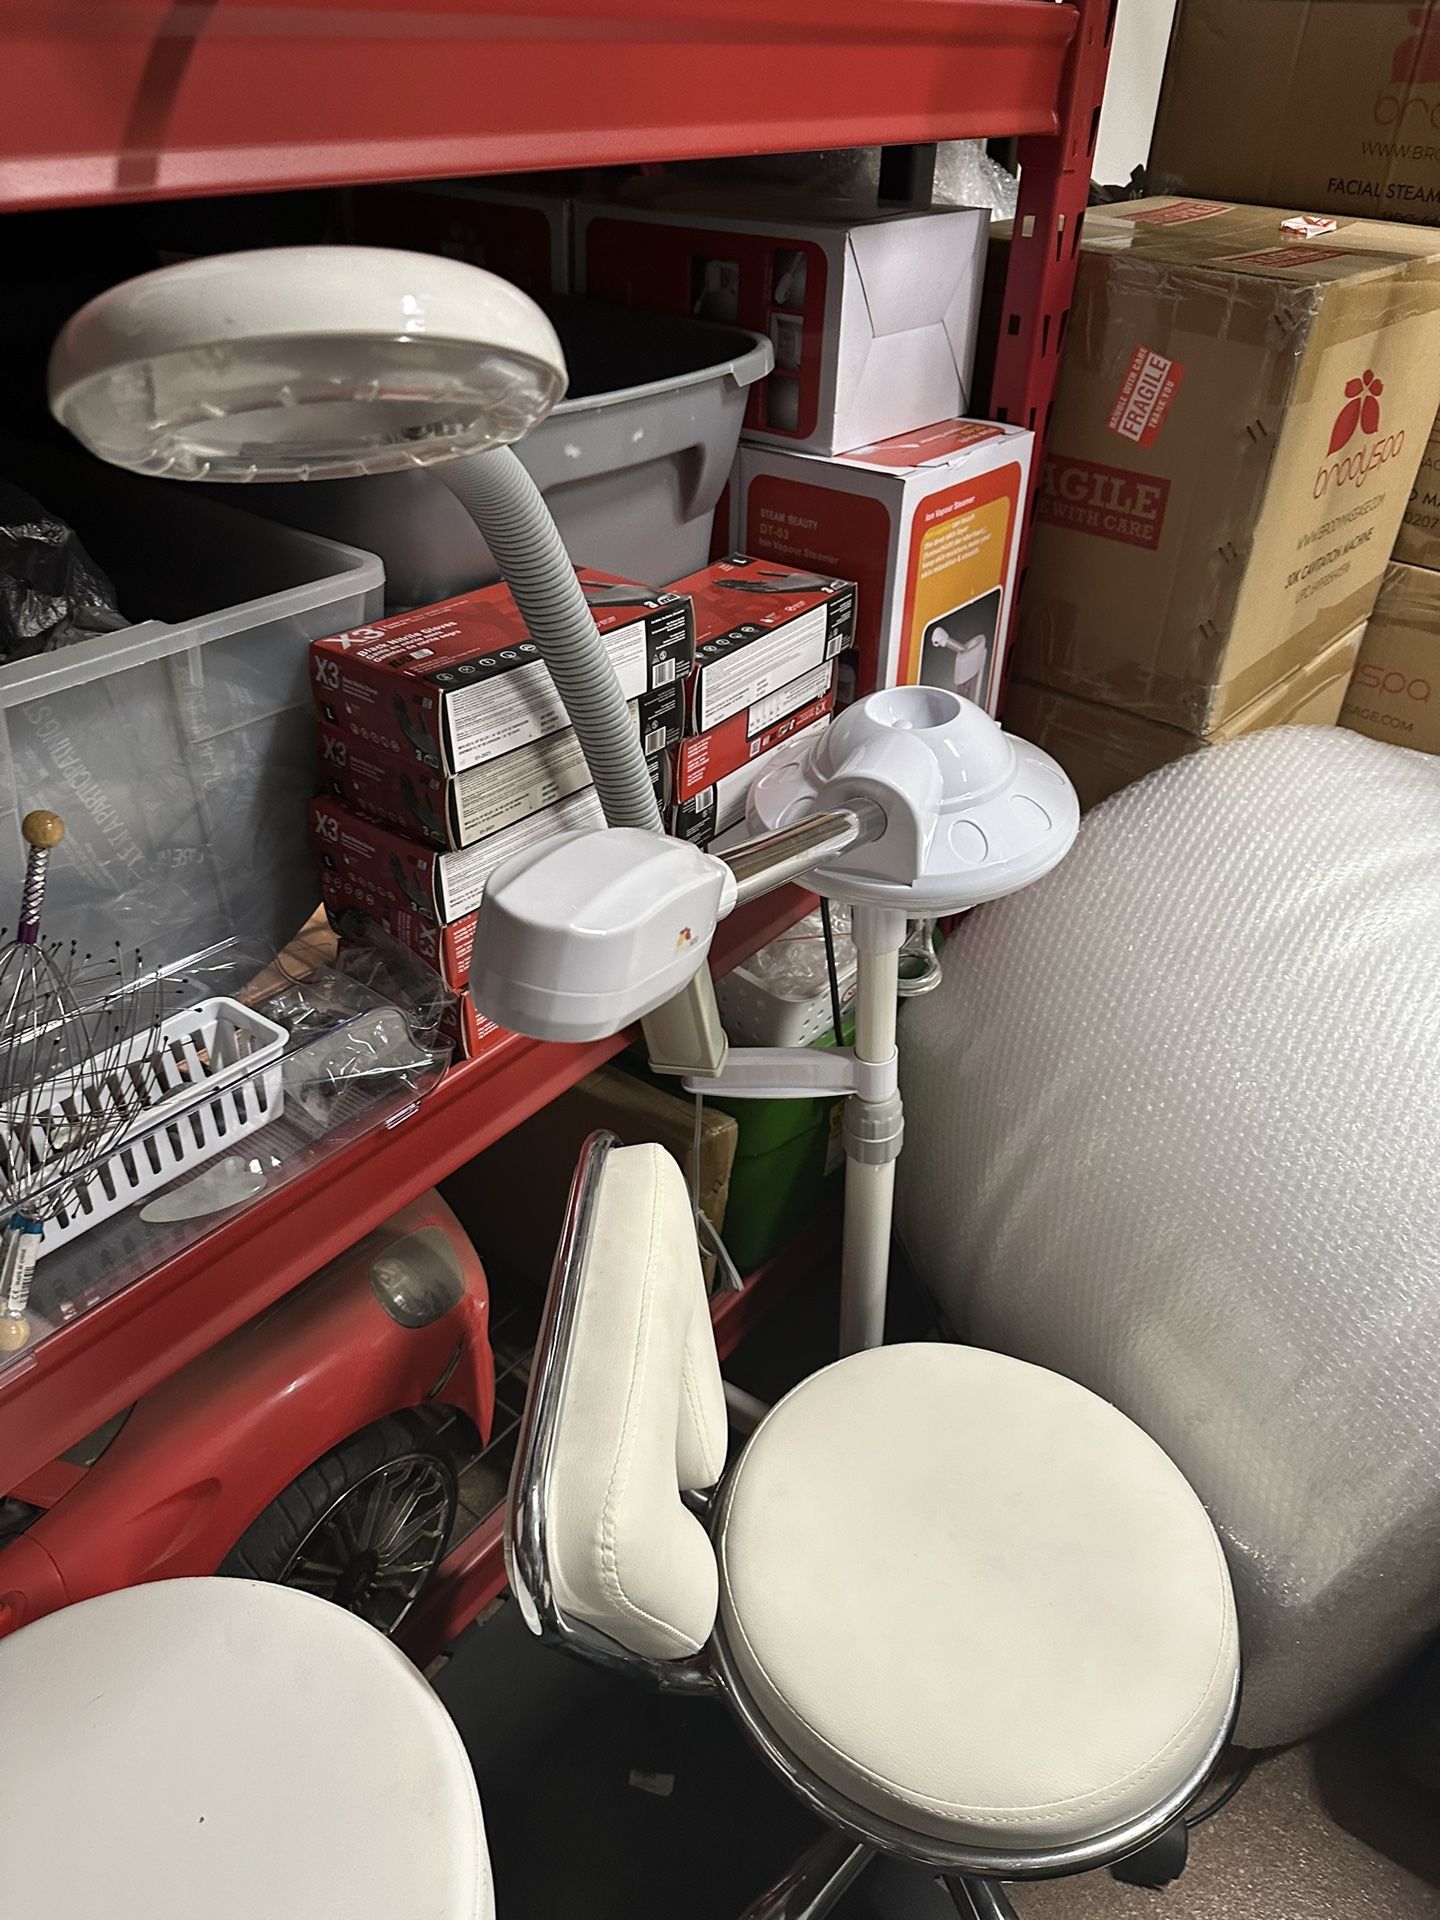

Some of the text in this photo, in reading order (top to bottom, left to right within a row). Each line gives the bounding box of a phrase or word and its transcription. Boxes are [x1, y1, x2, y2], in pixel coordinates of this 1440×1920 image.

[1327, 177, 1380, 198] FACIAL
[1109, 347, 1149, 429] HANDLE WITH CARE
[1123, 357, 1168, 436] FRAGILE
[1147, 380, 1175, 428] THANK YOU
[760, 508, 818, 530] STEAM BEAUTY
[760, 523, 790, 540] DT-03
[1053, 500, 1100, 528] WITH
[1103, 514, 1155, 540] CARE
[804, 548, 840, 565] Steamer
[322, 626, 386, 650] X3
[356, 621, 458, 657] Black Nitrile Gloves
[314, 655, 341, 689] X3
[323, 734, 347, 767] X3
[315, 809, 339, 842] X3
